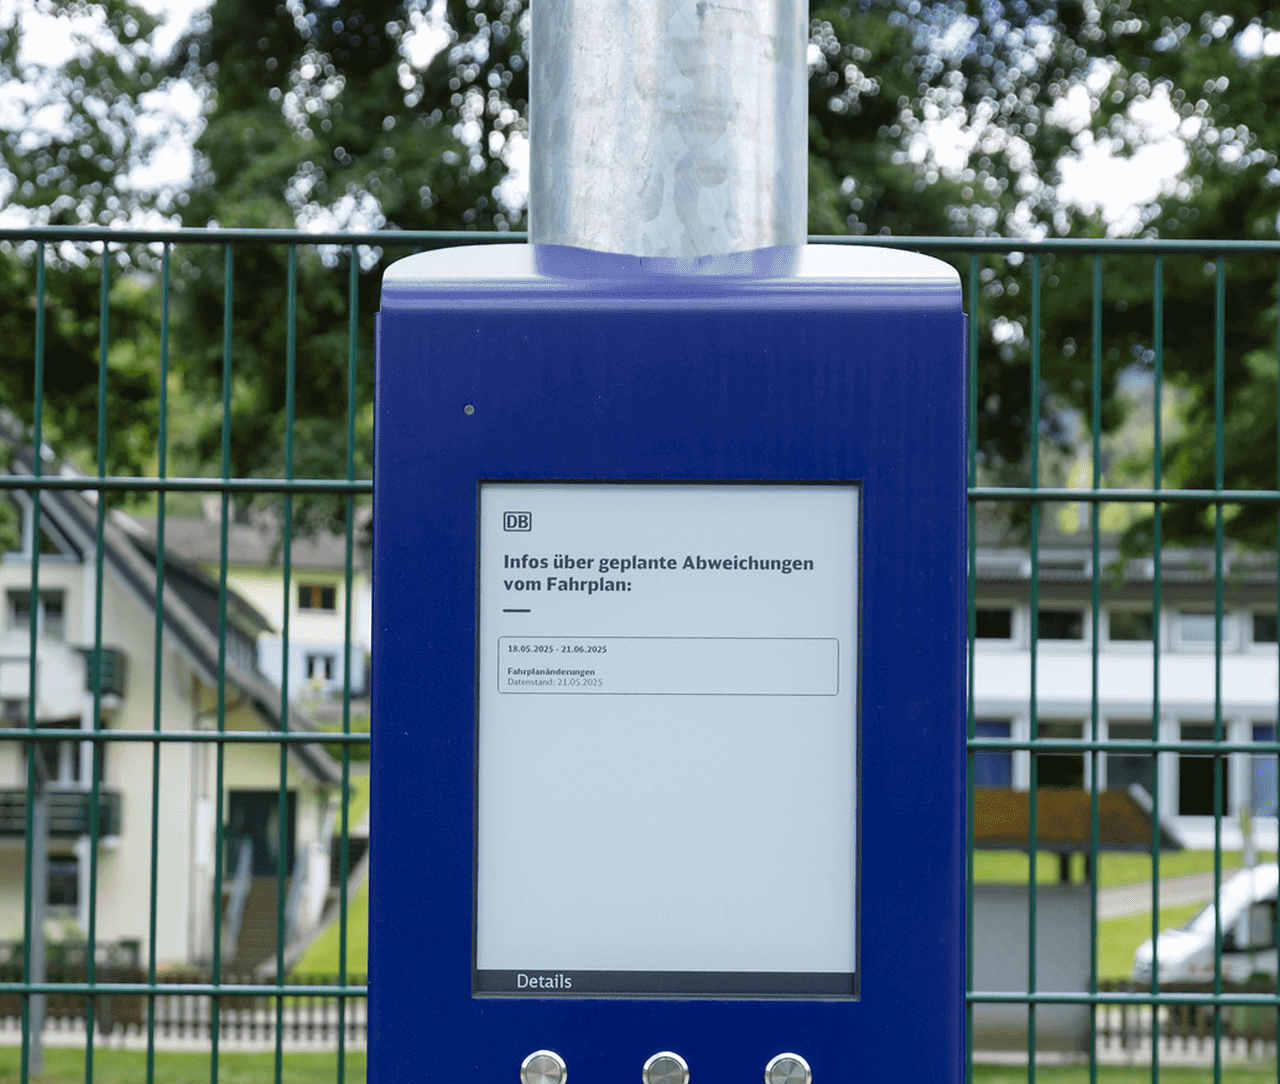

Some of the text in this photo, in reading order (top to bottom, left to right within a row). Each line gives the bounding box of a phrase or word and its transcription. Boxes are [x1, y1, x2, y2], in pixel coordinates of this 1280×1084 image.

[506, 514, 529, 529] DB
[504, 554, 815, 573] Infos über geplante Abweichungen
[503, 577, 632, 595] vom Fahrplan:
[508, 644, 554, 653] 18.05.2025
[561, 645, 608, 654] 21.06.2025
[508, 667, 596, 677] Fahrplanänderungen
[508, 678, 604, 687] Datenstand: 21.05.2025
[517, 974, 573, 989] Details
